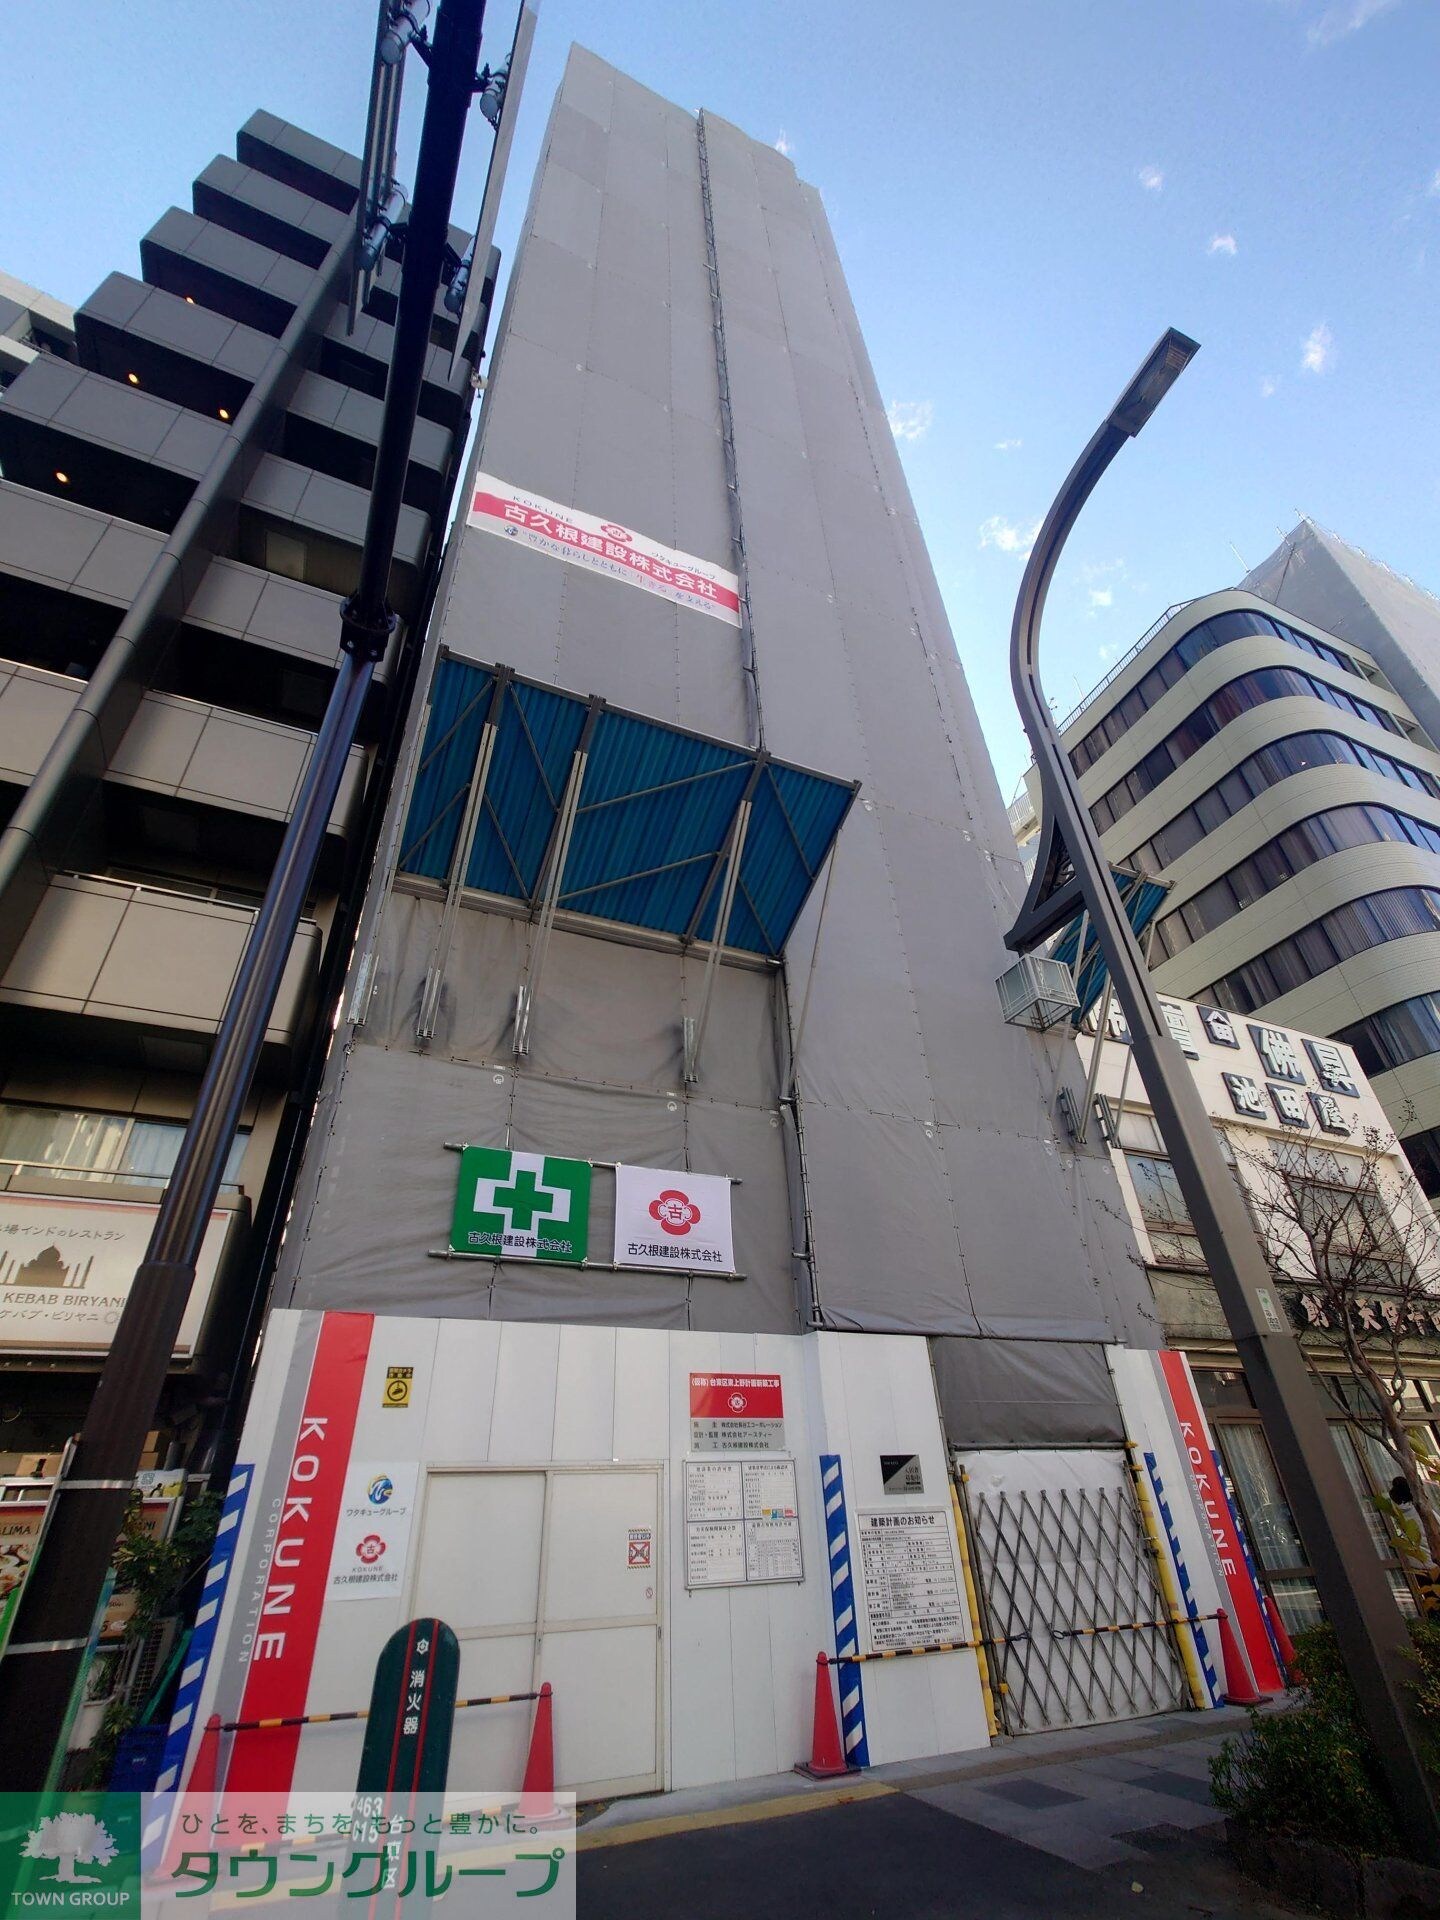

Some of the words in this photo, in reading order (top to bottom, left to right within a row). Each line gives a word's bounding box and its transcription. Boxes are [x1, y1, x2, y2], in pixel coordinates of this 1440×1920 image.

[513, 495, 573, 523] KOKUNE
[505, 503, 717, 599] 古久根建設株式会社
[0, 1225, 126, 1241] 場インドのレストラン
[468, 1232, 573, 1253] 古久根建設株式会社
[627, 1244, 723, 1263] 古久根建設株式会社
[4, 1293, 58, 1305] KEBAB
[63, 1295, 127, 1308] BIRYANI
[1180, 1422, 1236, 1575] KOKUNE
[346, 1508, 406, 1518] ワタキューグループ
[870, 1516, 935, 1527] 建築計画のお知らせ
[0, 1525, 31, 1535] LIMA
[253, 1417, 328, 1661] KOKUNE
[238, 1498, 281, 1664] CORPORATION
[333, 1573, 398, 1584] 古久根建設株式会社
[403, 1670, 426, 1736] 消火器
